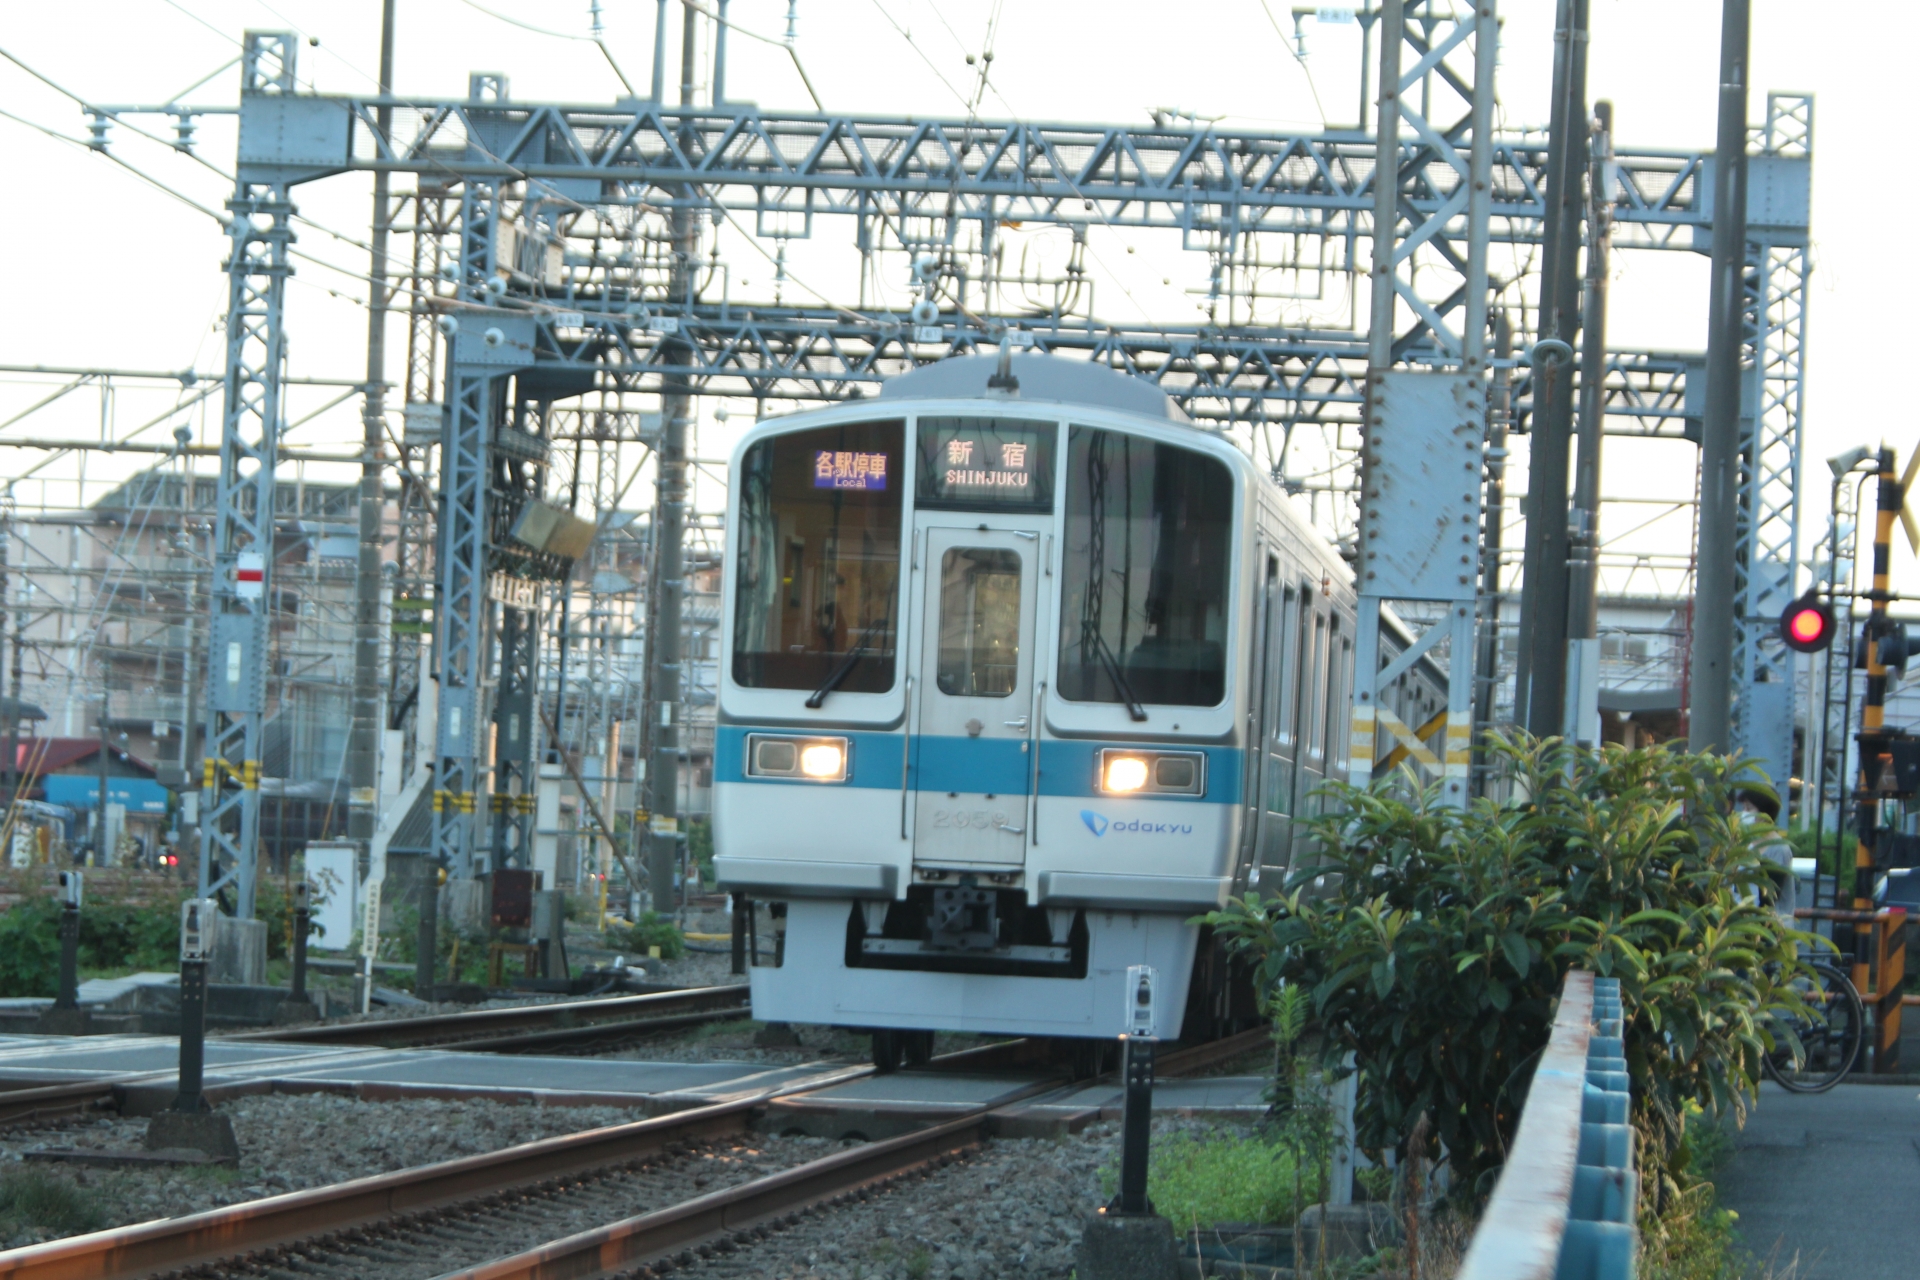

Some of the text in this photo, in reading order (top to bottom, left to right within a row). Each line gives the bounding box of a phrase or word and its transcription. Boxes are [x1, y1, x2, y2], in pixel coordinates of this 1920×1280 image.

[816, 451, 886, 479] 各駅停車
[948, 440, 1027, 468] 新宿
[835, 478, 866, 488] Local
[946, 469, 1028, 487] SHINJUKU
